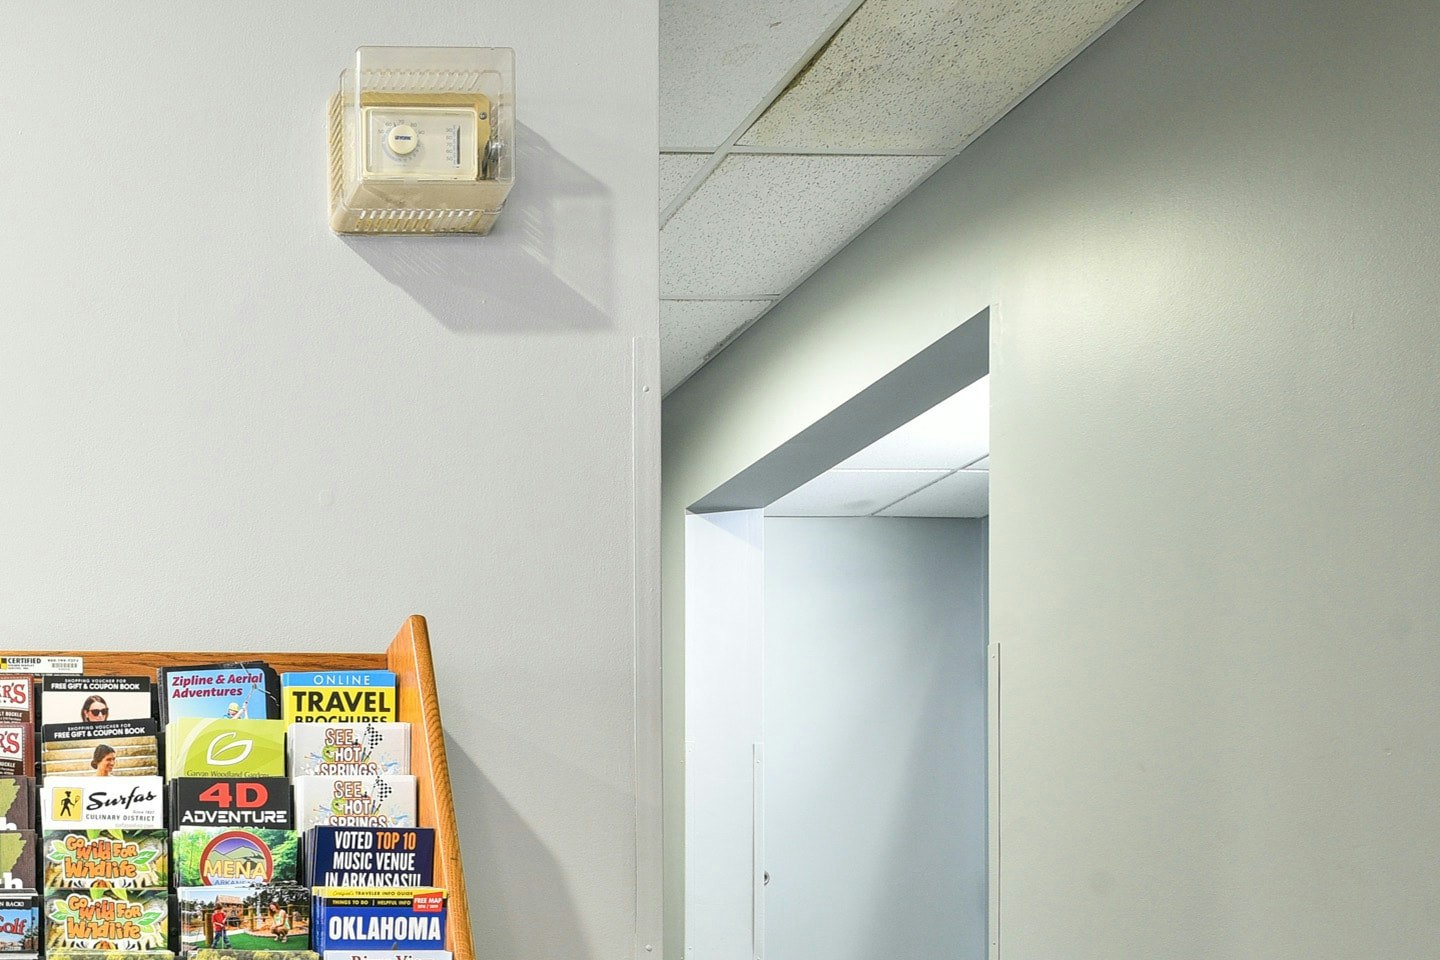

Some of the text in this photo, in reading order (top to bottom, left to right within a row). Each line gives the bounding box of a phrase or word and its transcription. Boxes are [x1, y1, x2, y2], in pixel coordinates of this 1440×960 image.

[172, 672, 263, 690] Zipline & Aerial
[313, 674, 371, 686] ONLINE
[172, 687, 243, 699] Adventures
[292, 691, 391, 713] TRAVEL
[70, 731, 86, 739] GIFT
[93, 728, 124, 737] COUPON
[124, 727, 146, 735] BOOK
[326, 728, 353, 748] SEE
[334, 748, 362, 763] HOT
[86, 786, 157, 811] Surfas
[199, 782, 269, 808] 4D
[333, 781, 362, 800] SEE
[85, 813, 120, 821] CULINARY
[181, 810, 288, 824] ADVENTURE
[344, 800, 371, 815] HOT
[334, 830, 417, 851] VOTED TOP 10
[64, 856, 137, 879] Wildlife
[203, 859, 268, 878] MENA
[332, 852, 416, 871] MUSIC VENUE
[325, 872, 340, 888] IN
[67, 917, 141, 939] Wildlife
[329, 916, 441, 941] OKLAHOMA
